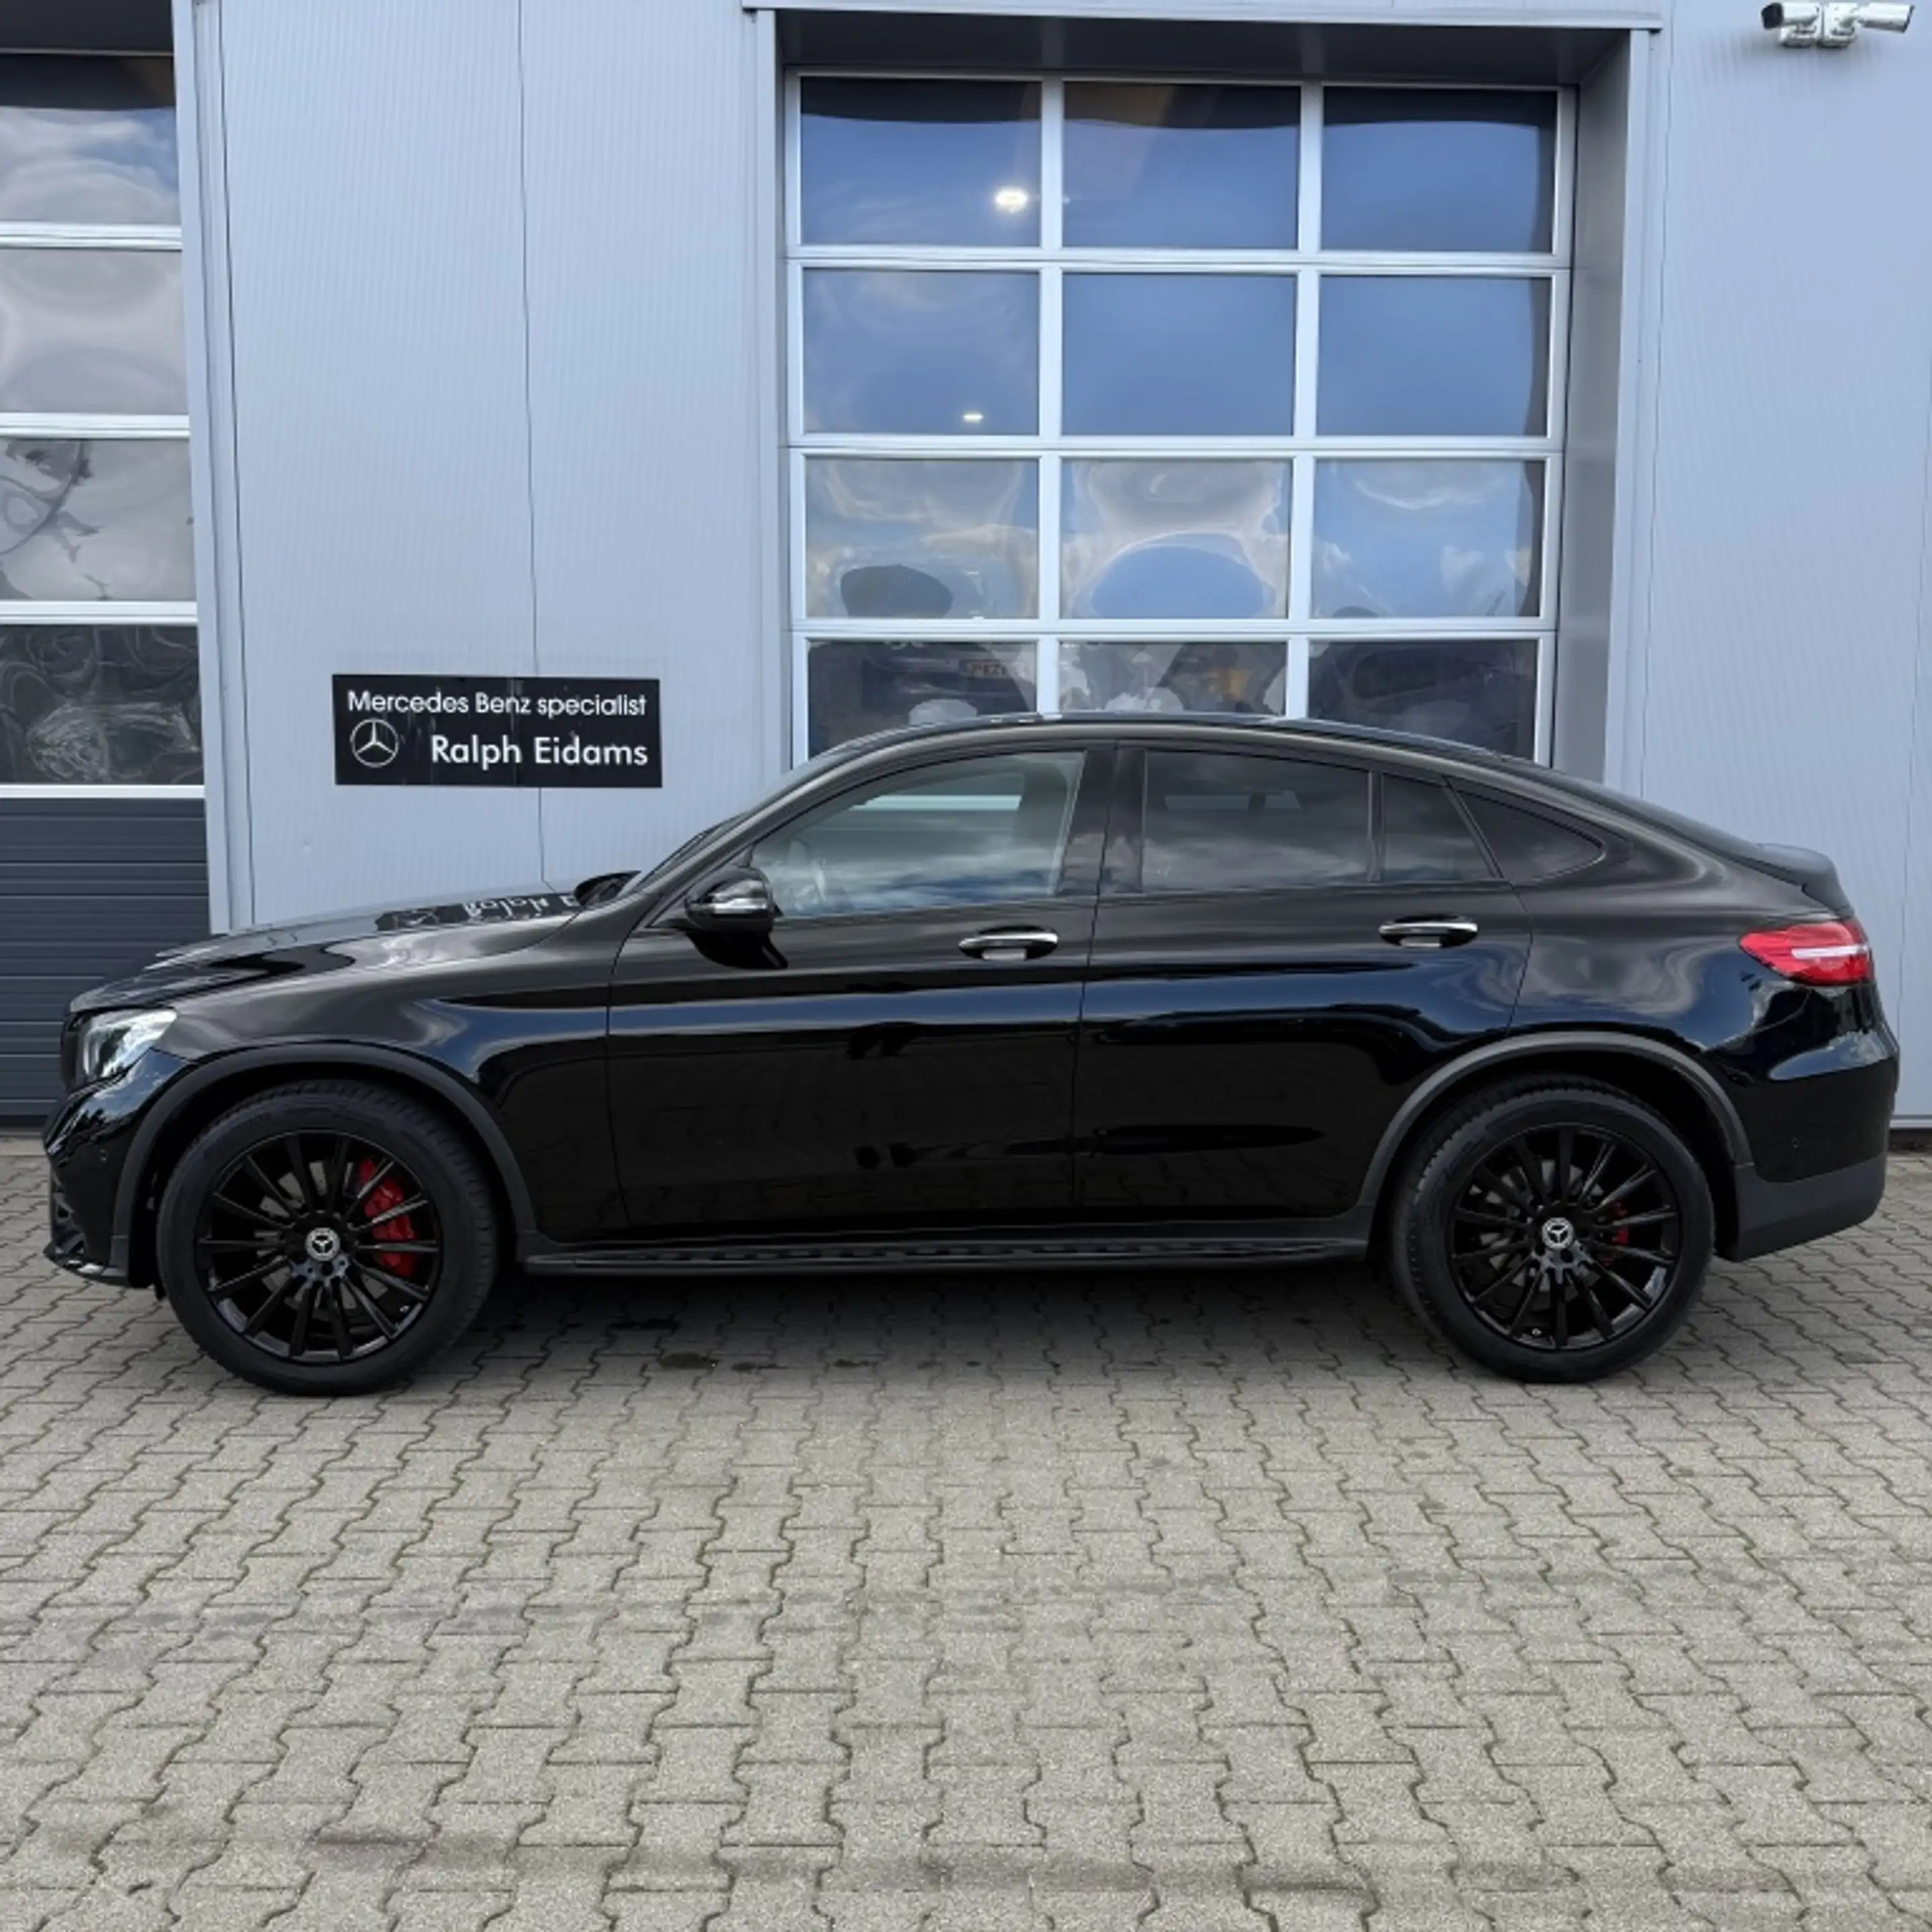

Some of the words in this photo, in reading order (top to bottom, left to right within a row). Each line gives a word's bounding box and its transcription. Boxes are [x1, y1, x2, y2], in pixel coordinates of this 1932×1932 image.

[347, 690, 469, 713] Mercedes
[475, 692, 531, 714] Benz
[537, 694, 647, 718] specialist
[431, 735, 523, 770] Ralph
[534, 737, 649, 765] Eidams
